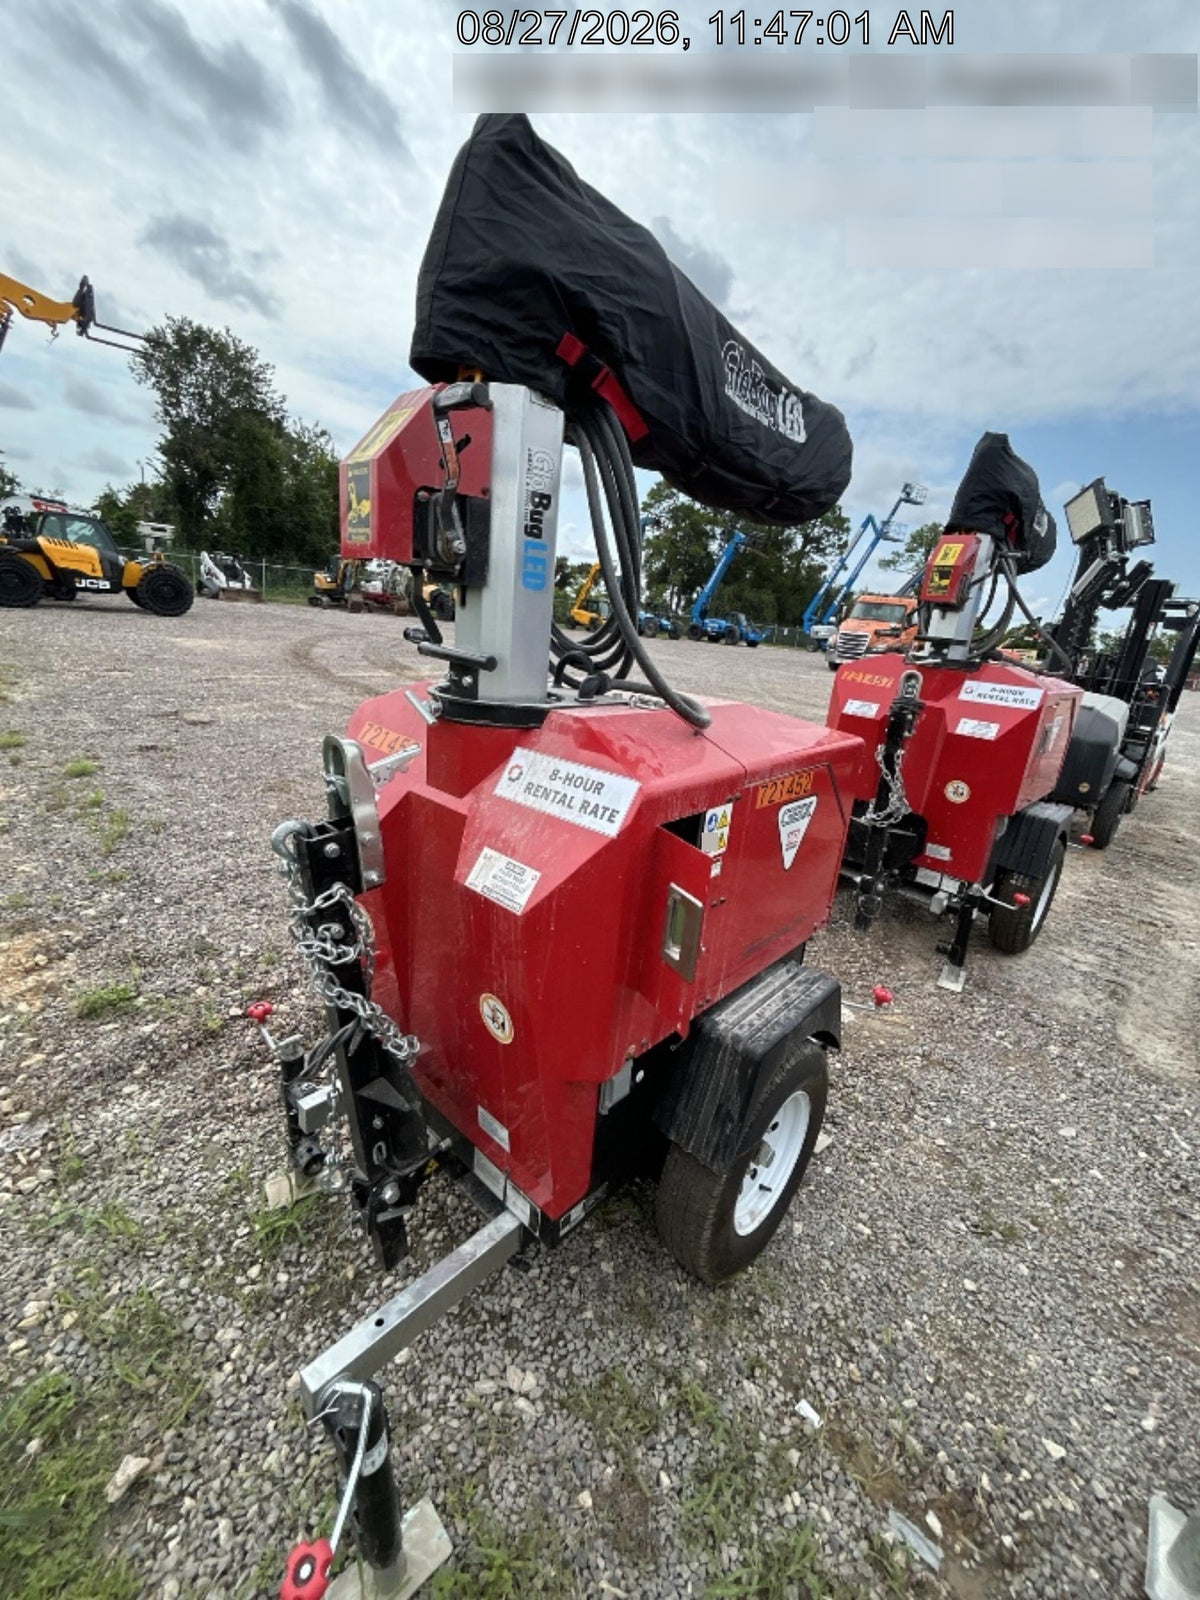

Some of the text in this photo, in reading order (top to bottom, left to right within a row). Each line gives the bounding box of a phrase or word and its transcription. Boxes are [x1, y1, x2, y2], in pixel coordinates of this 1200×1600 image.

[75, 579, 111, 589] JCB
[360, 722, 420, 753] 72145
[549, 769, 605, 795] 8-HOUR
[523, 781, 620, 824] RENTAL RATE
